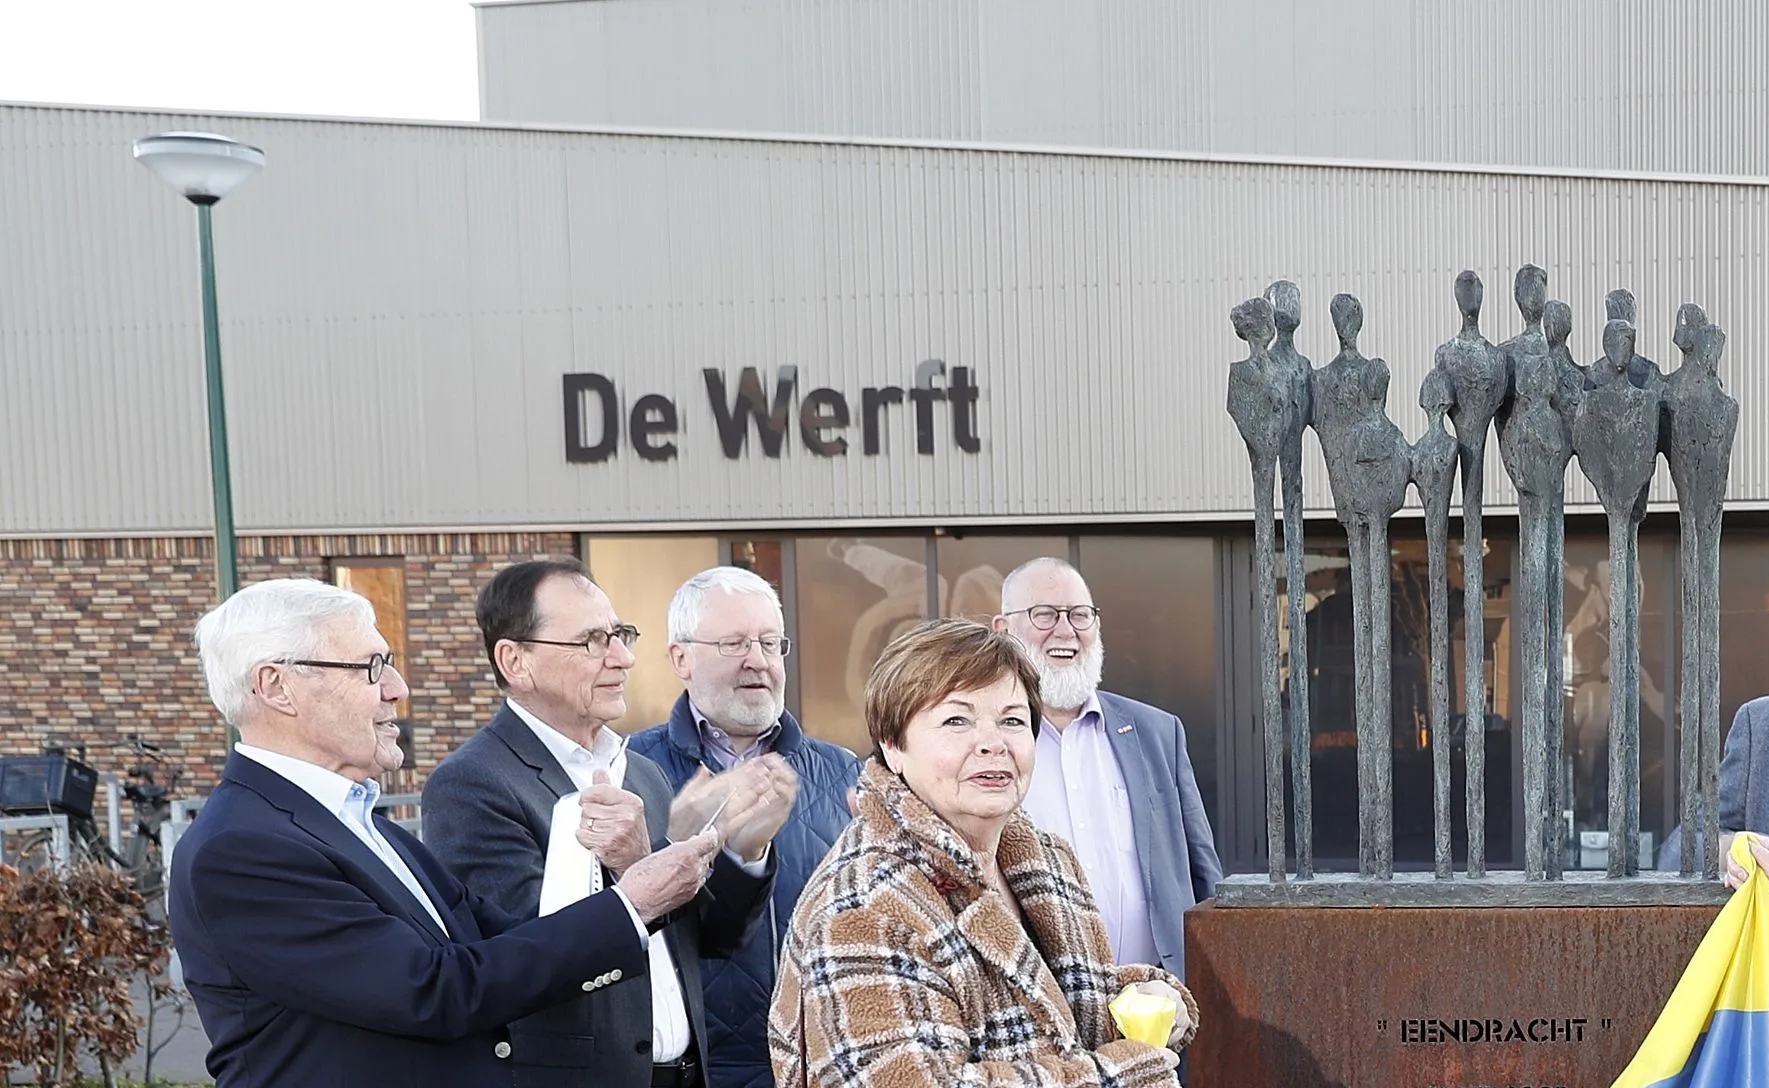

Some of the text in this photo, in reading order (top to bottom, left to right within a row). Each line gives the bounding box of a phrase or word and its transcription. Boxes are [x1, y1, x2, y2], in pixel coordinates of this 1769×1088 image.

[562, 359, 981, 463] De Werft
[1401, 1018, 1588, 1043] EENDRACHT
